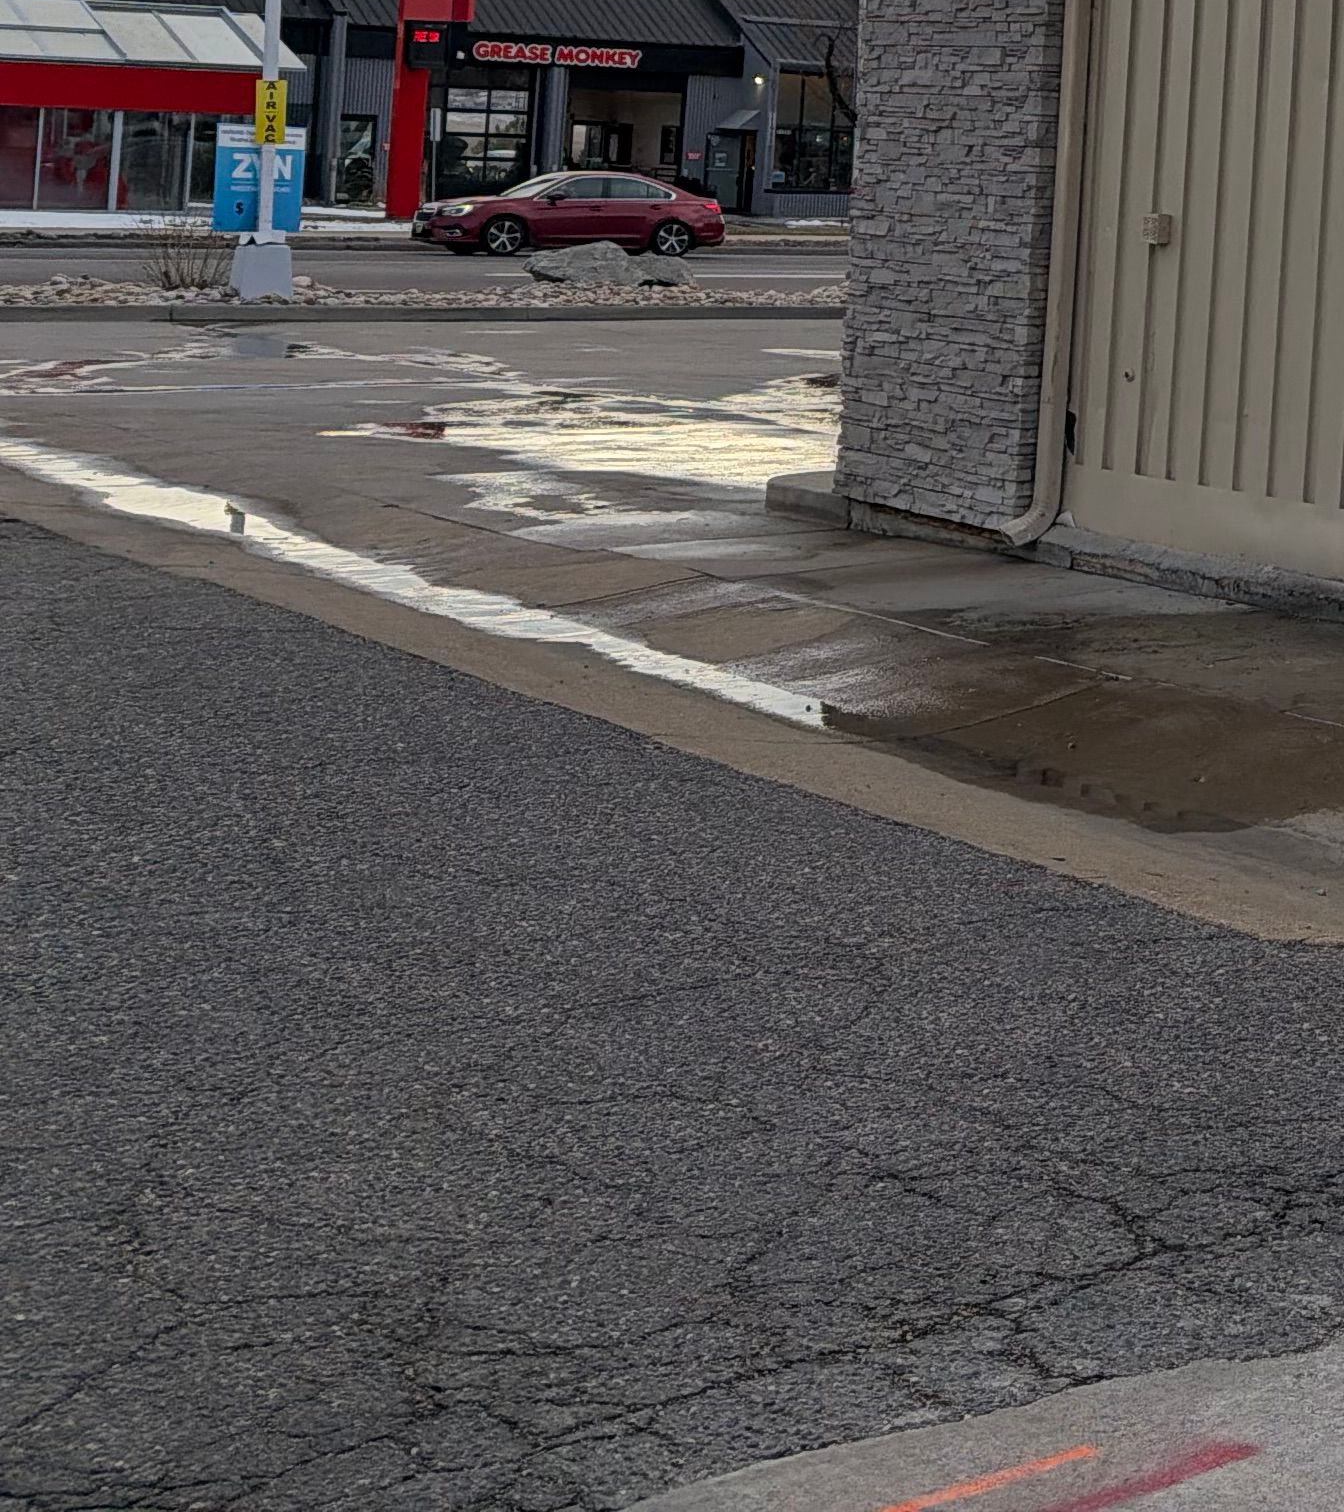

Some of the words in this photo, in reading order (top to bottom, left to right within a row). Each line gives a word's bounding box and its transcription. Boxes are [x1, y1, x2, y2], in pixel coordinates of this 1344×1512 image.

[473, 41, 552, 64] GREASE
[555, 45, 642, 68] MONKEY
[265, 81, 277, 110] AIR
[264, 115, 276, 143] VAC
